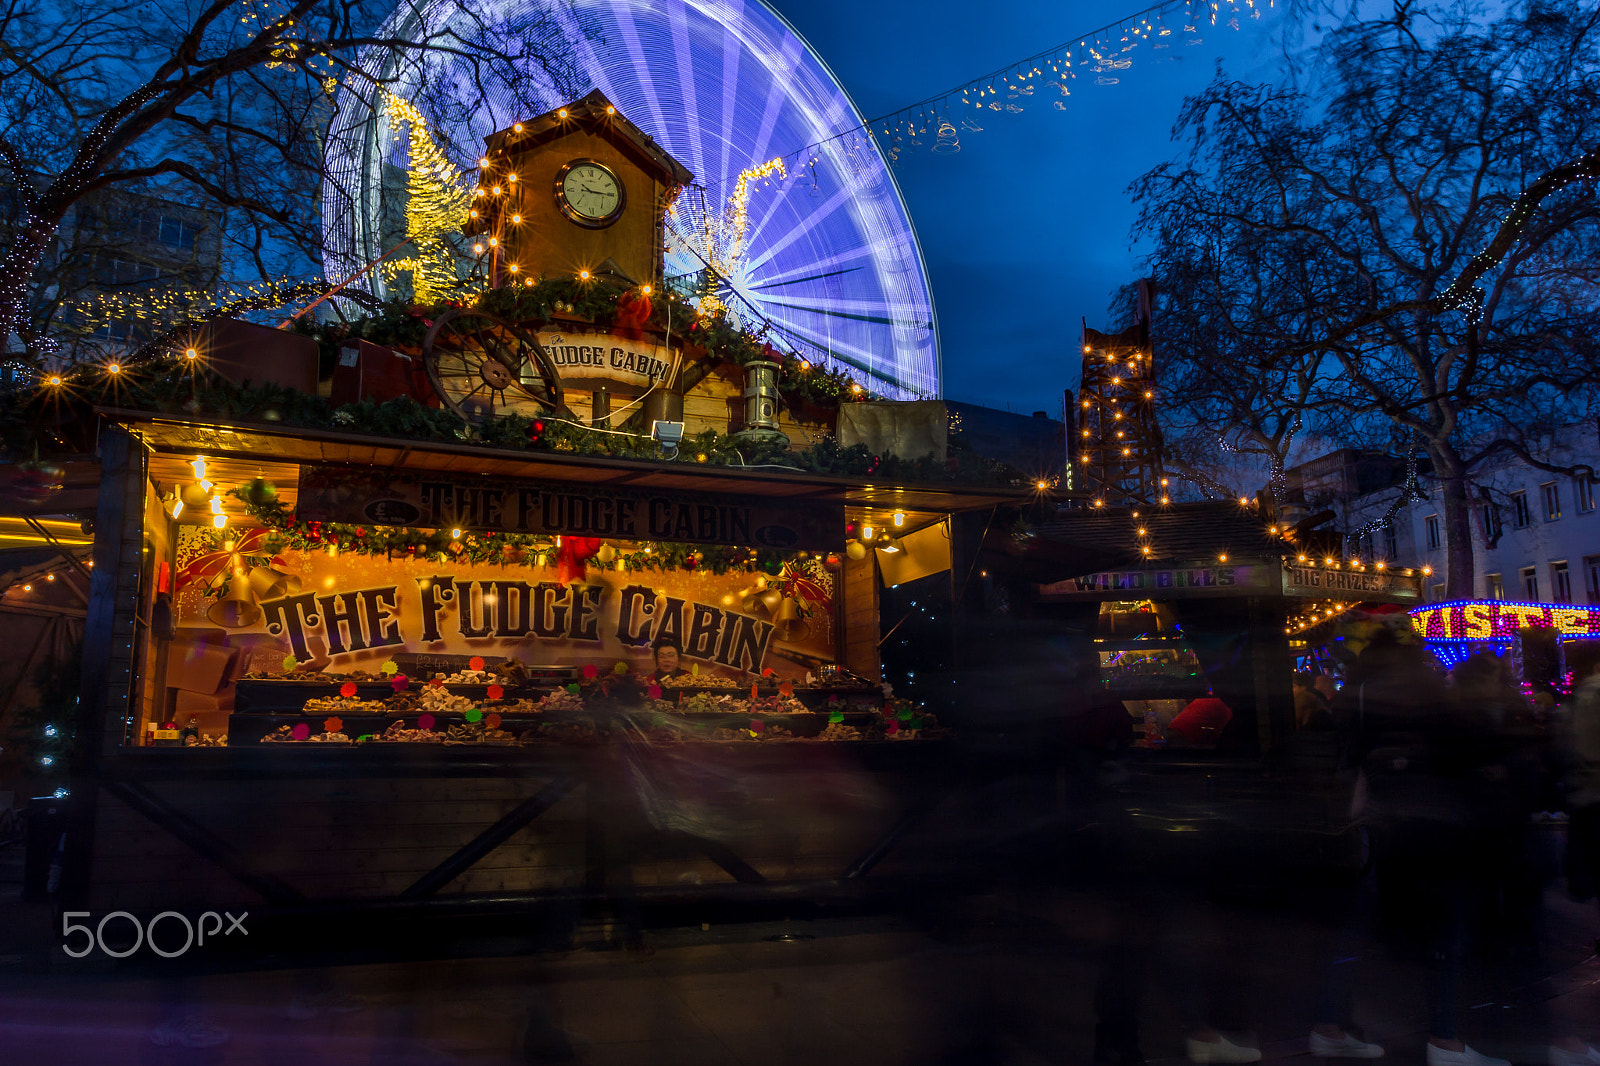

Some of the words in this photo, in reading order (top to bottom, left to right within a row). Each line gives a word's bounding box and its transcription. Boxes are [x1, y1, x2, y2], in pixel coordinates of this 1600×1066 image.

[609, 347, 669, 381] CABIN
[417, 482, 506, 531] THE
[518, 487, 636, 535] FUDGE
[648, 498, 751, 543] CABIN
[1074, 571, 1146, 591] WILD
[1293, 568, 1321, 588] BIG
[1325, 570, 1381, 592] PRIZES
[259, 586, 404, 665] THE
[413, 575, 605, 643] FUDGE
[615, 584, 776, 676] CABIN
